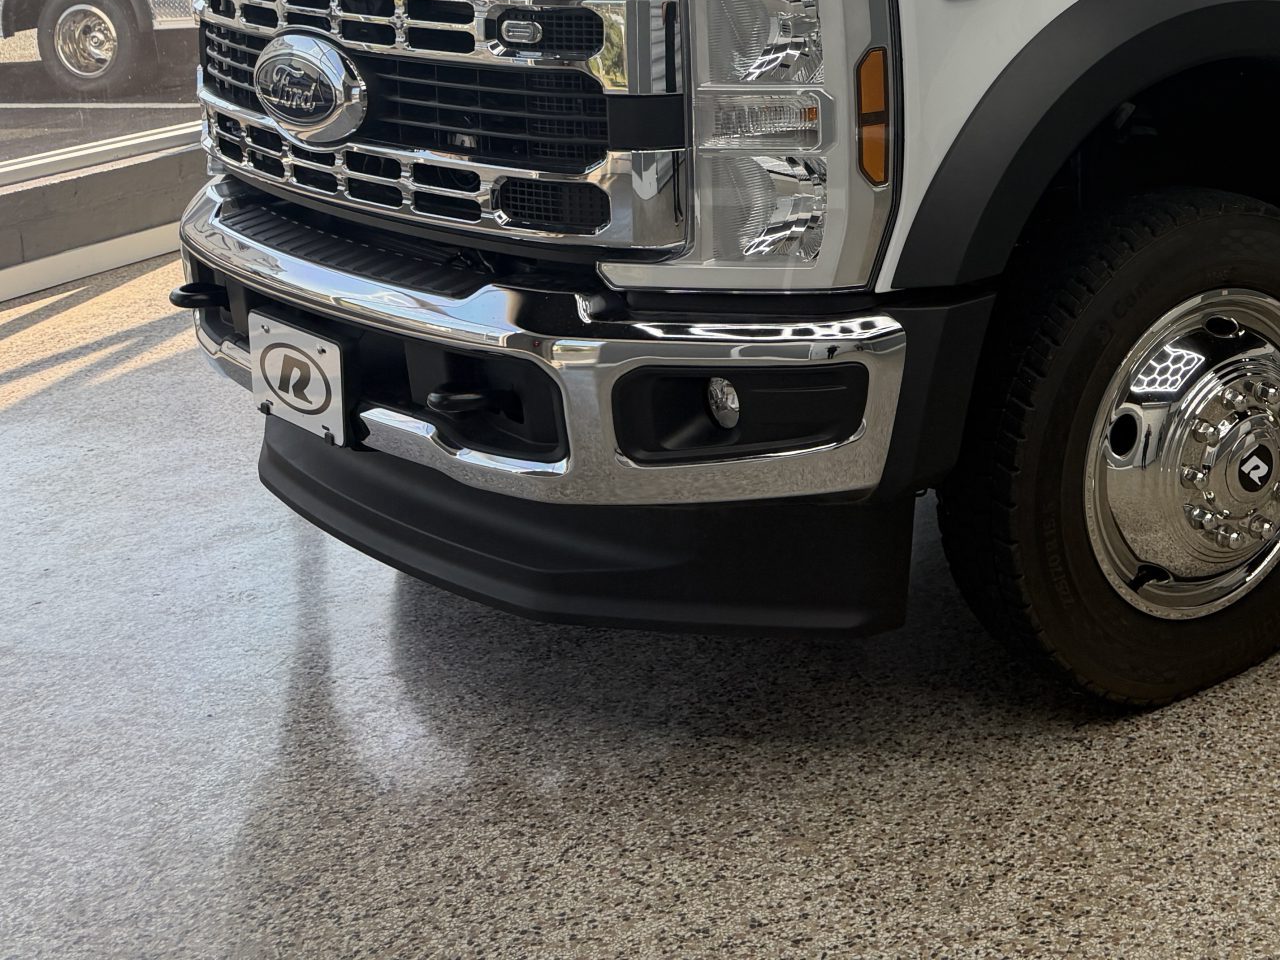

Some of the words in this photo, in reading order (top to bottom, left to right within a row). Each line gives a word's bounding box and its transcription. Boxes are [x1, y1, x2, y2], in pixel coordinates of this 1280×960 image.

[269, 64, 316, 112] Ford
[278, 353, 313, 405] R
[1240, 455, 1269, 486] R
